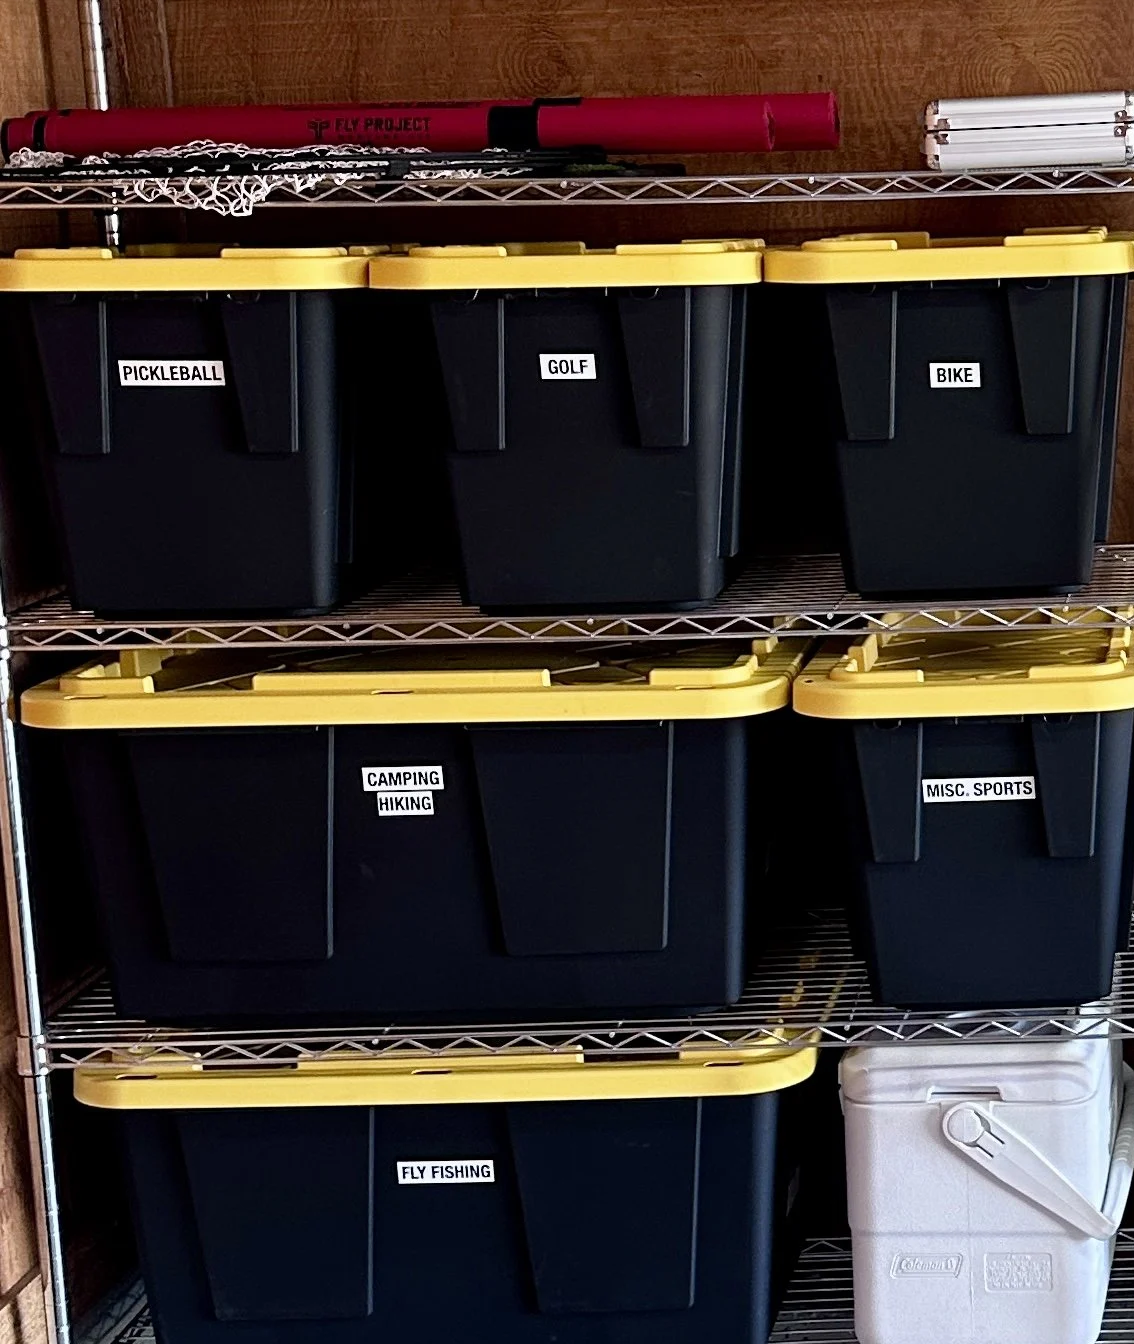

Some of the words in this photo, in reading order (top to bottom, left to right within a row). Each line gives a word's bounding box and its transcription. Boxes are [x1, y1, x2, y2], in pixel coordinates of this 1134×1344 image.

[335, 117, 359, 132] FLY
[364, 117, 432, 132] PROJECT
[122, 365, 223, 381] PICKLEBALL
[548, 359, 589, 375] GOLF
[936, 367, 974, 383] BIKE
[367, 770, 440, 787] CAMPING
[926, 783, 970, 798] MISC.
[973, 780, 1033, 797] SPORTS
[378, 796, 432, 812] HIKING
[401, 1165, 427, 1180] FLY
[431, 1164, 491, 1179] FISHING
